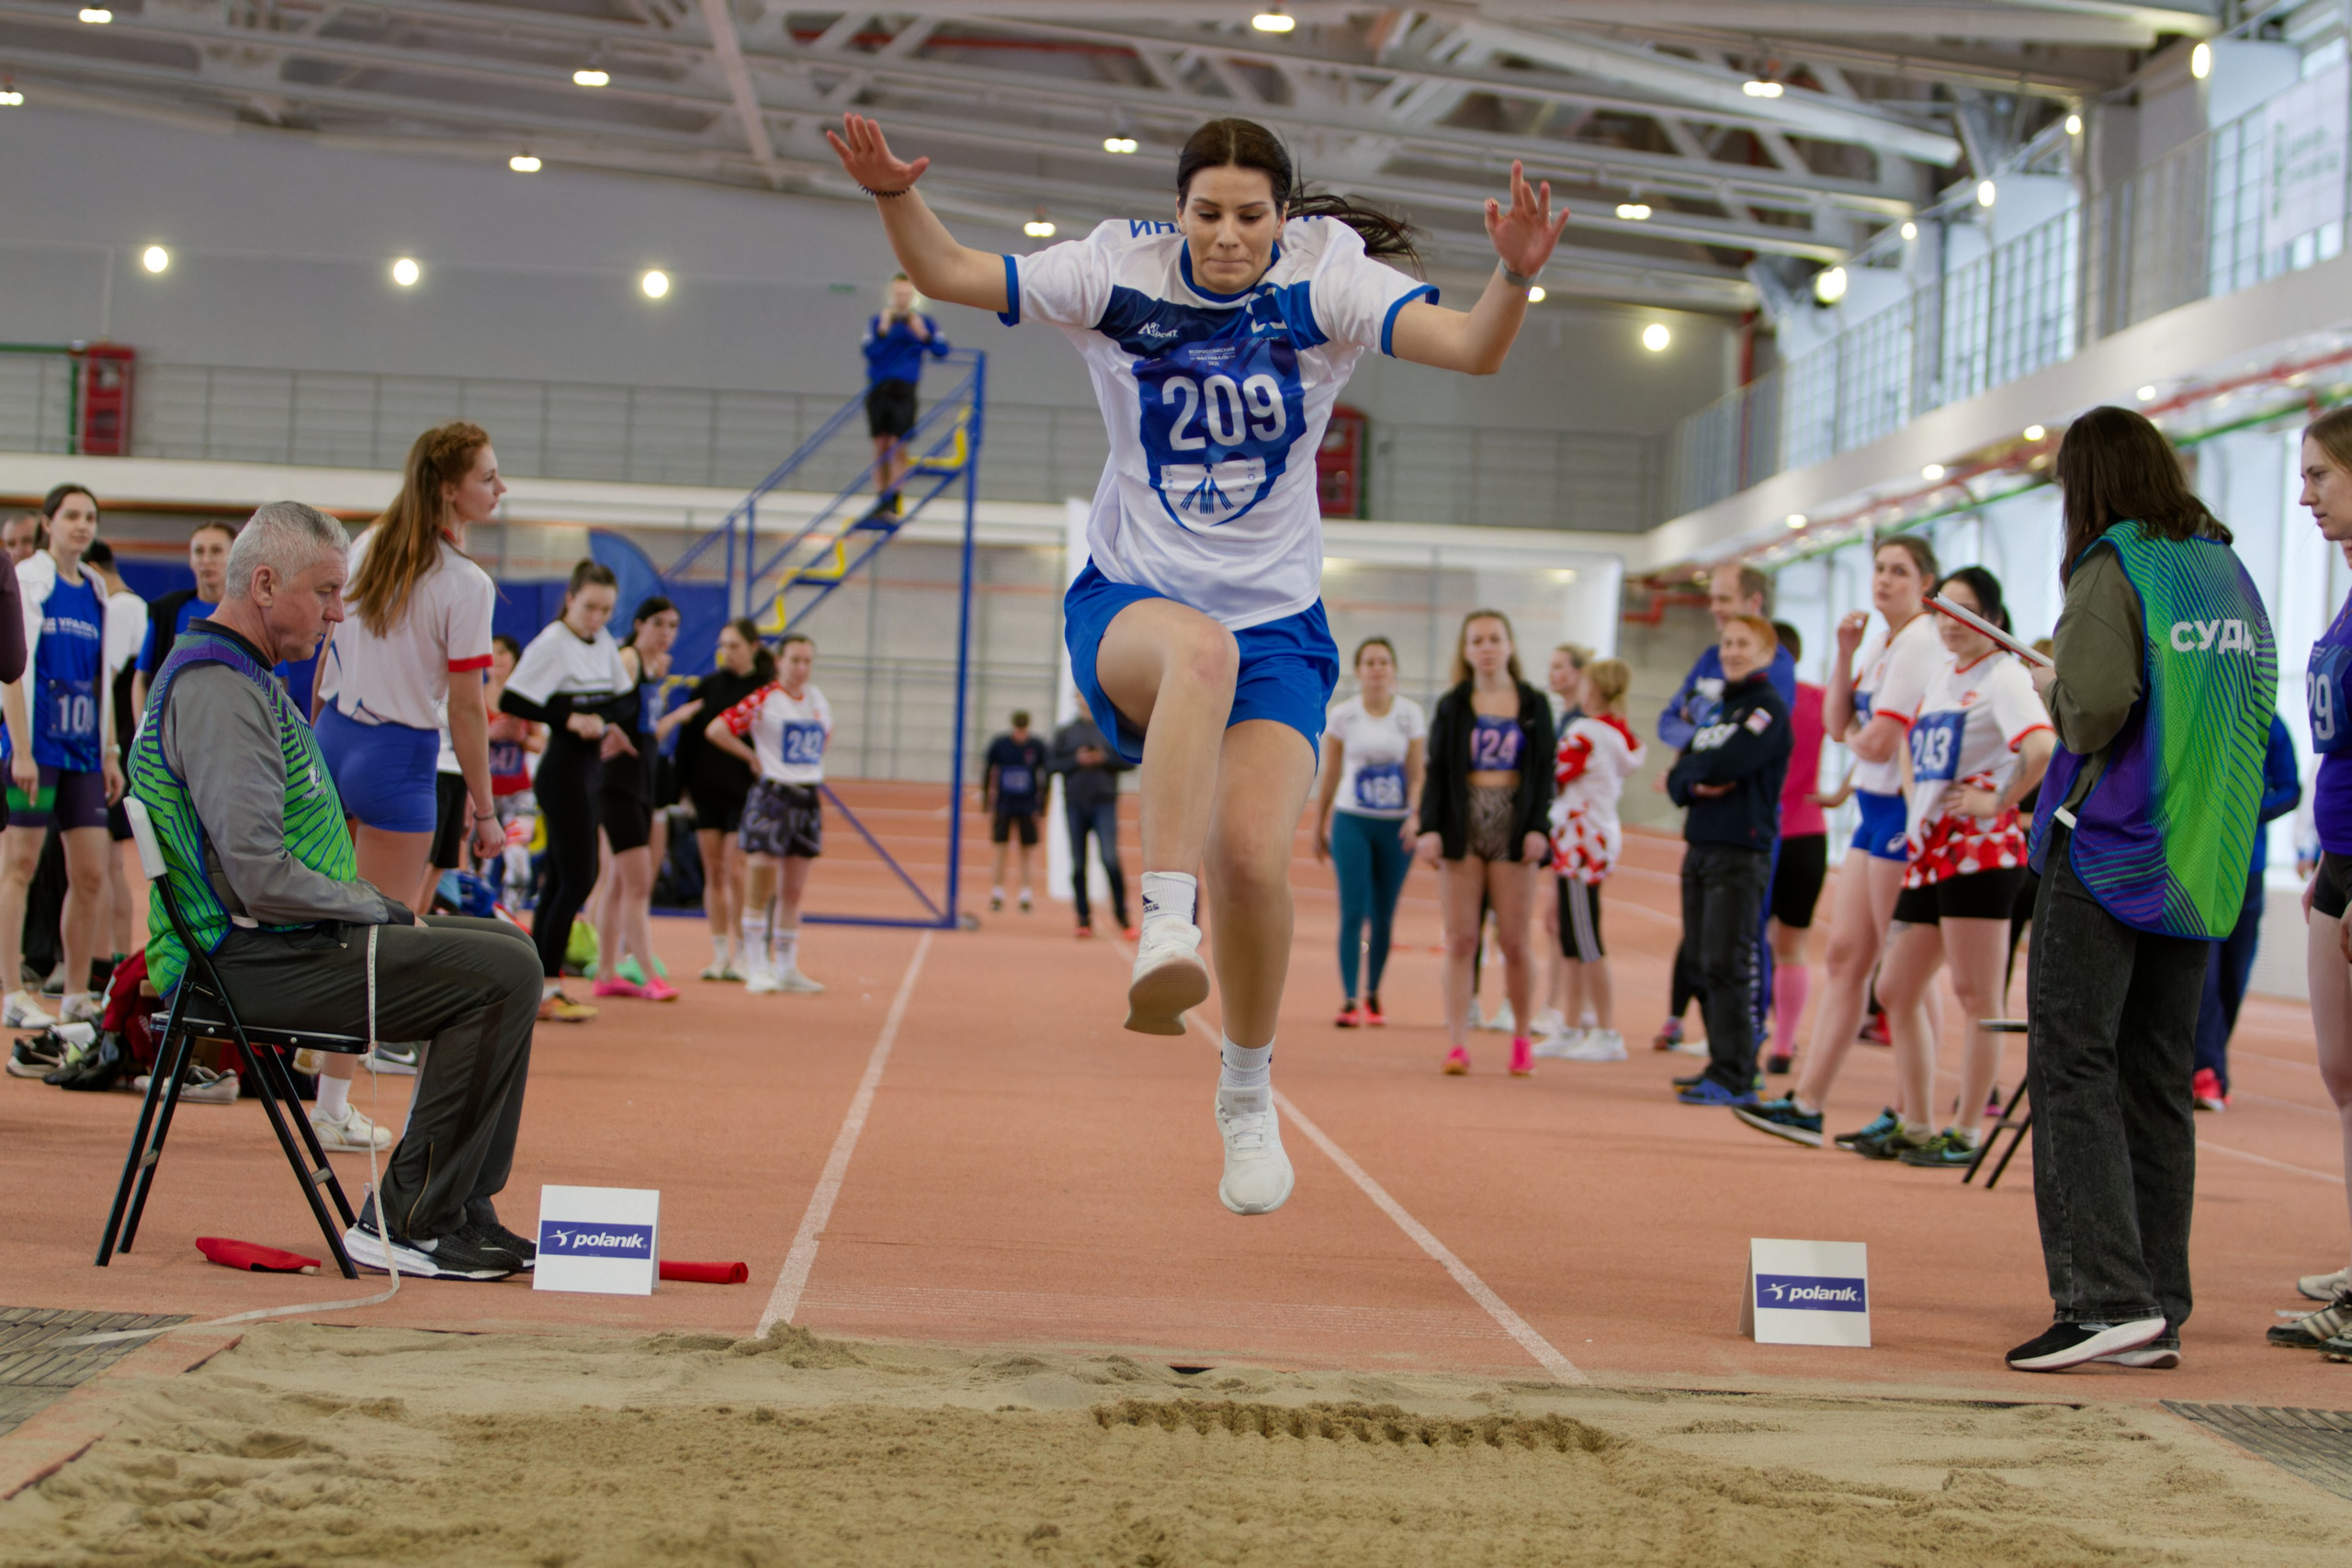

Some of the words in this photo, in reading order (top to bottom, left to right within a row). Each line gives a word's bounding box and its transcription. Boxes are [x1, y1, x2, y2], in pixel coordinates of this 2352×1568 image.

[1162, 374, 1286, 451] 209
[1471, 728, 1517, 763] 124
[1912, 726, 1952, 772] 243
